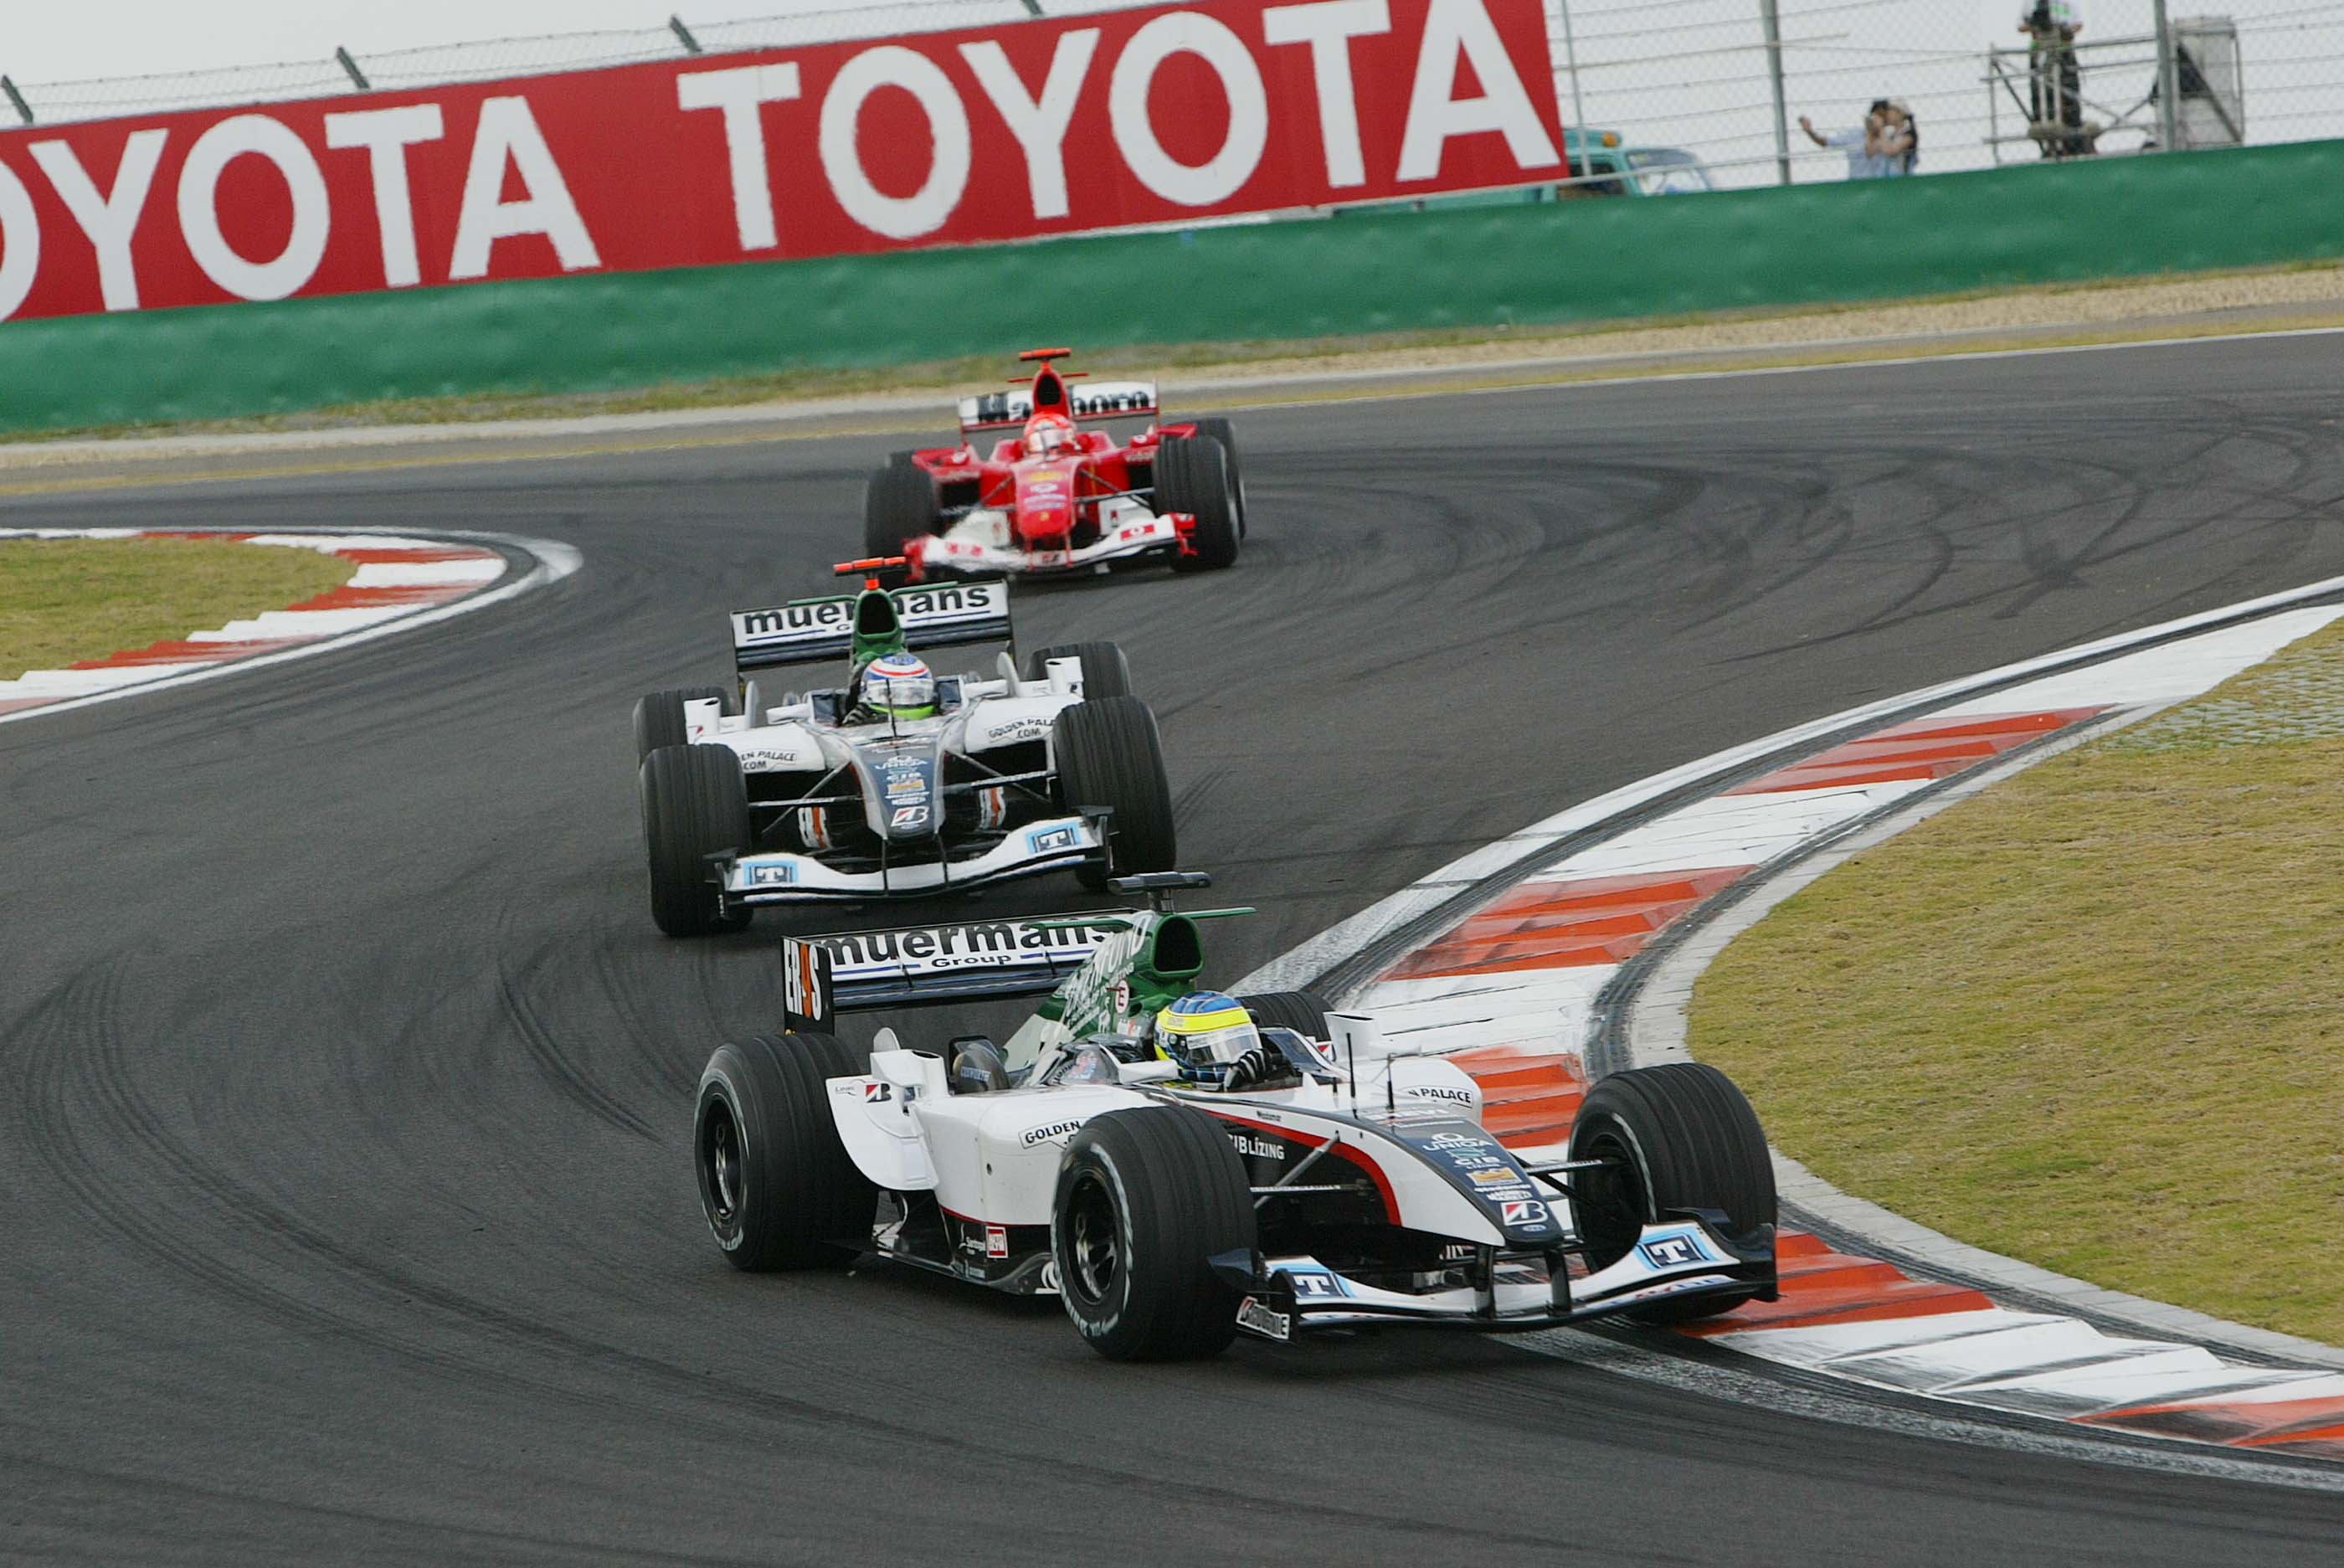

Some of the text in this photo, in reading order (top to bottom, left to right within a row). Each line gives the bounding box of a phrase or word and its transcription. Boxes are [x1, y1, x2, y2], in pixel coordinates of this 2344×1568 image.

[0, 0, 1560, 322] YOTA TOYOTA
[744, 587, 990, 634] muerans
[931, 954, 1012, 969] Group
[1421, 1087, 1472, 1103] PALACE
[1026, 1120, 1082, 1144] GOLDEN
